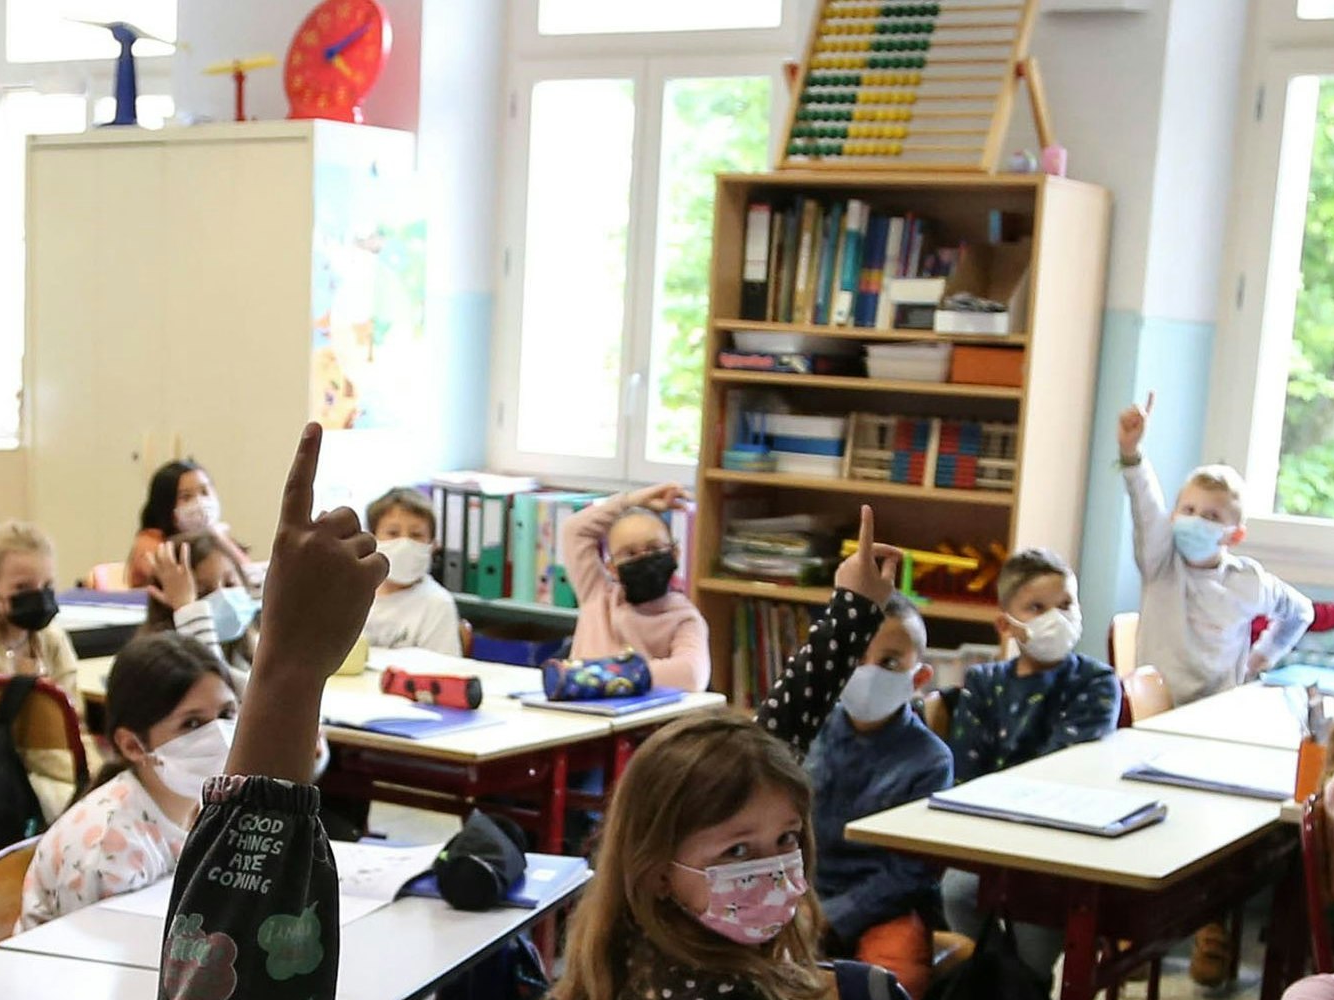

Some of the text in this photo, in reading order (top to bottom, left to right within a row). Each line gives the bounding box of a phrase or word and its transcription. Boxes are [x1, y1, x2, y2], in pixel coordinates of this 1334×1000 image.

[238, 814, 284, 834] GOOD
[227, 829, 284, 855] THINGS
[228, 852, 267, 872] ARE
[207, 866, 272, 894] COMING
